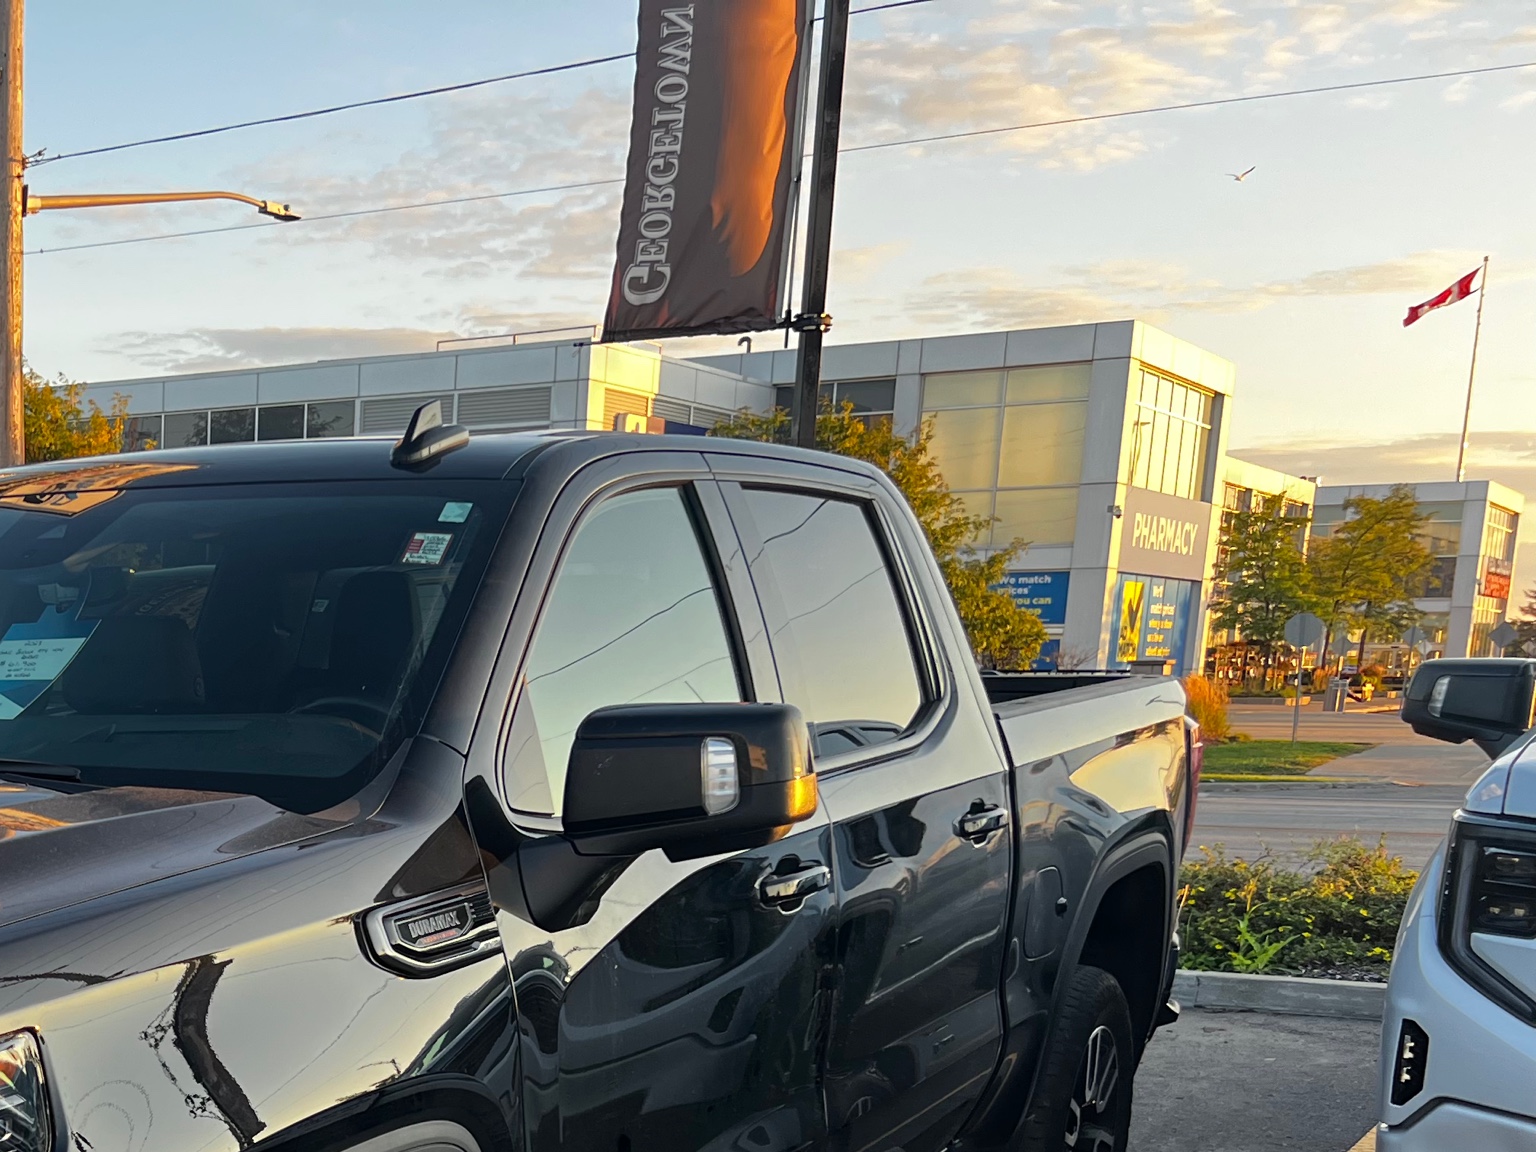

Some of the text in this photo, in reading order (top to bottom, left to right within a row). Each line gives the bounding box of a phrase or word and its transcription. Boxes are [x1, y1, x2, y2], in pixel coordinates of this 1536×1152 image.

[1131, 512, 1199, 556] PHARMACY
[1018, 574, 1052, 584] match
[1032, 597, 1052, 605] can
[407, 910, 461, 938] DURAMAX
